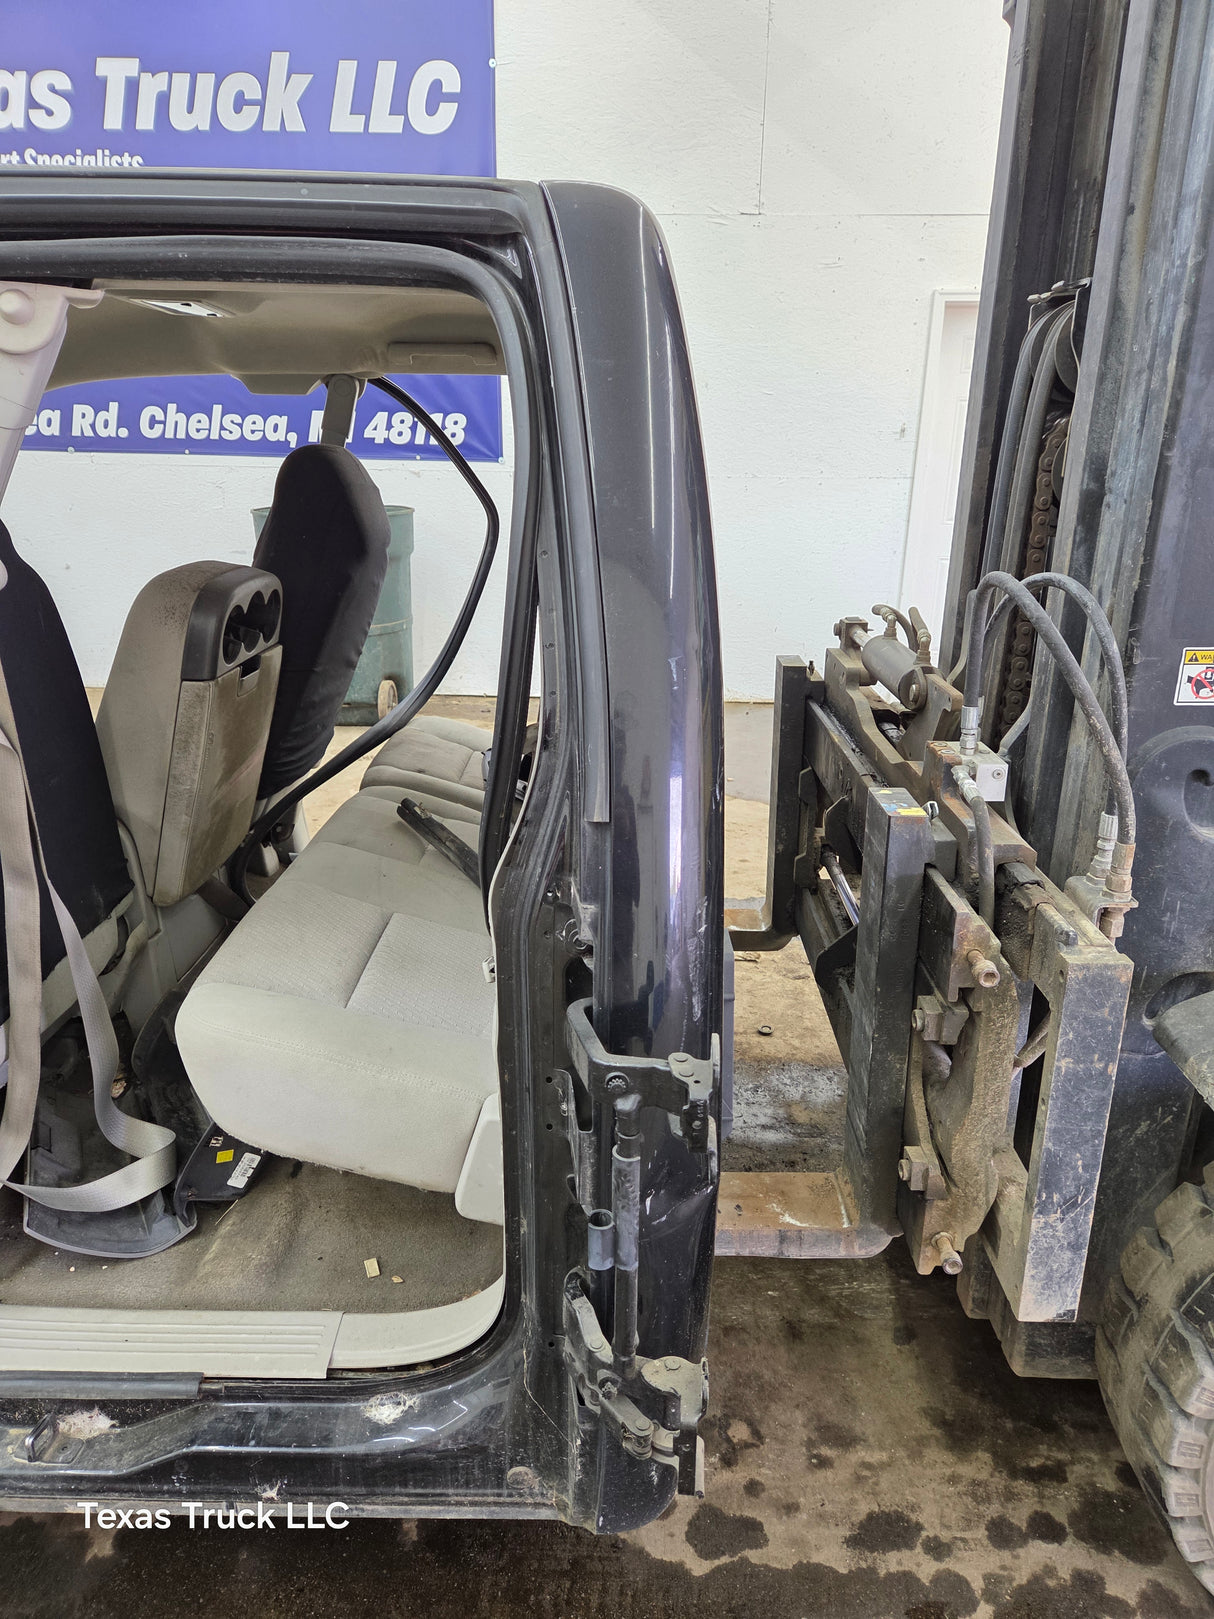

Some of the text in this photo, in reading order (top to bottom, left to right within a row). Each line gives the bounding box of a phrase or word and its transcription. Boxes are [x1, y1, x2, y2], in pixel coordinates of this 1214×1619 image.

[95, 51, 314, 132] Truck
[329, 60, 462, 134] LLC
[71, 401, 129, 438] Rd.
[139, 403, 298, 448] Chelsea,
